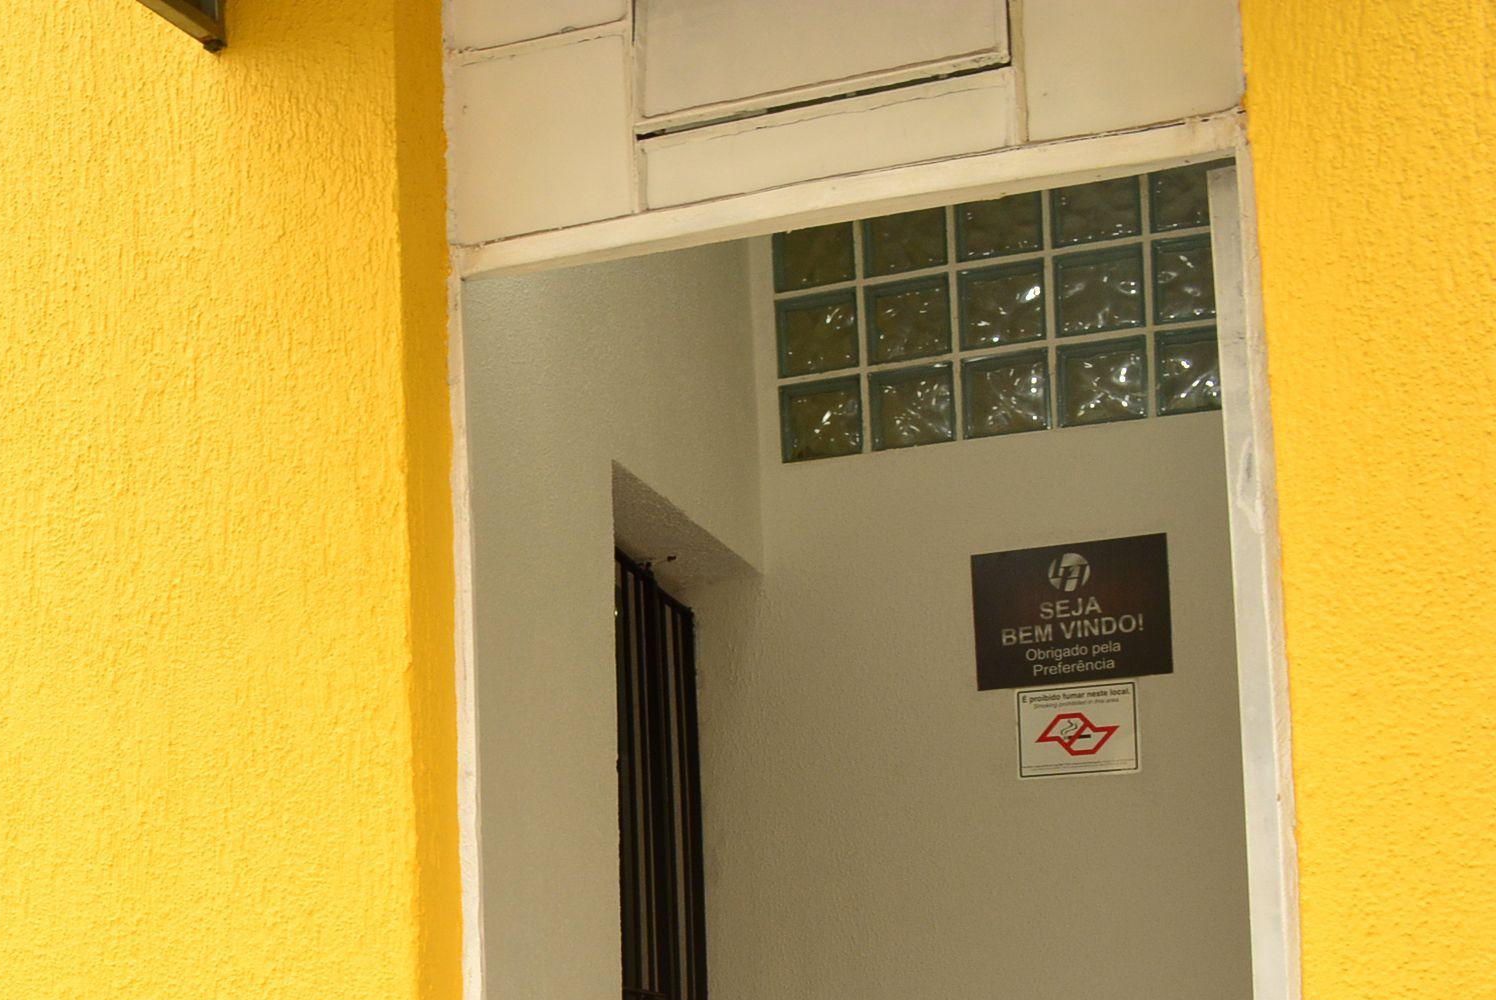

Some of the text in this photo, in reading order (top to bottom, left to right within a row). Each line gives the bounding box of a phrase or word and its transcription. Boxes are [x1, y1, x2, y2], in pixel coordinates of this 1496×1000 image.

[1039, 597, 1102, 619] SEJA
[1001, 614, 1144, 646] BEM VINDO!
[1026, 641, 1121, 661] Obrigado pela
[1033, 657, 1115, 676] Preferência
[1029, 694, 1061, 704] proibido
[1062, 692, 1086, 700] fumar
